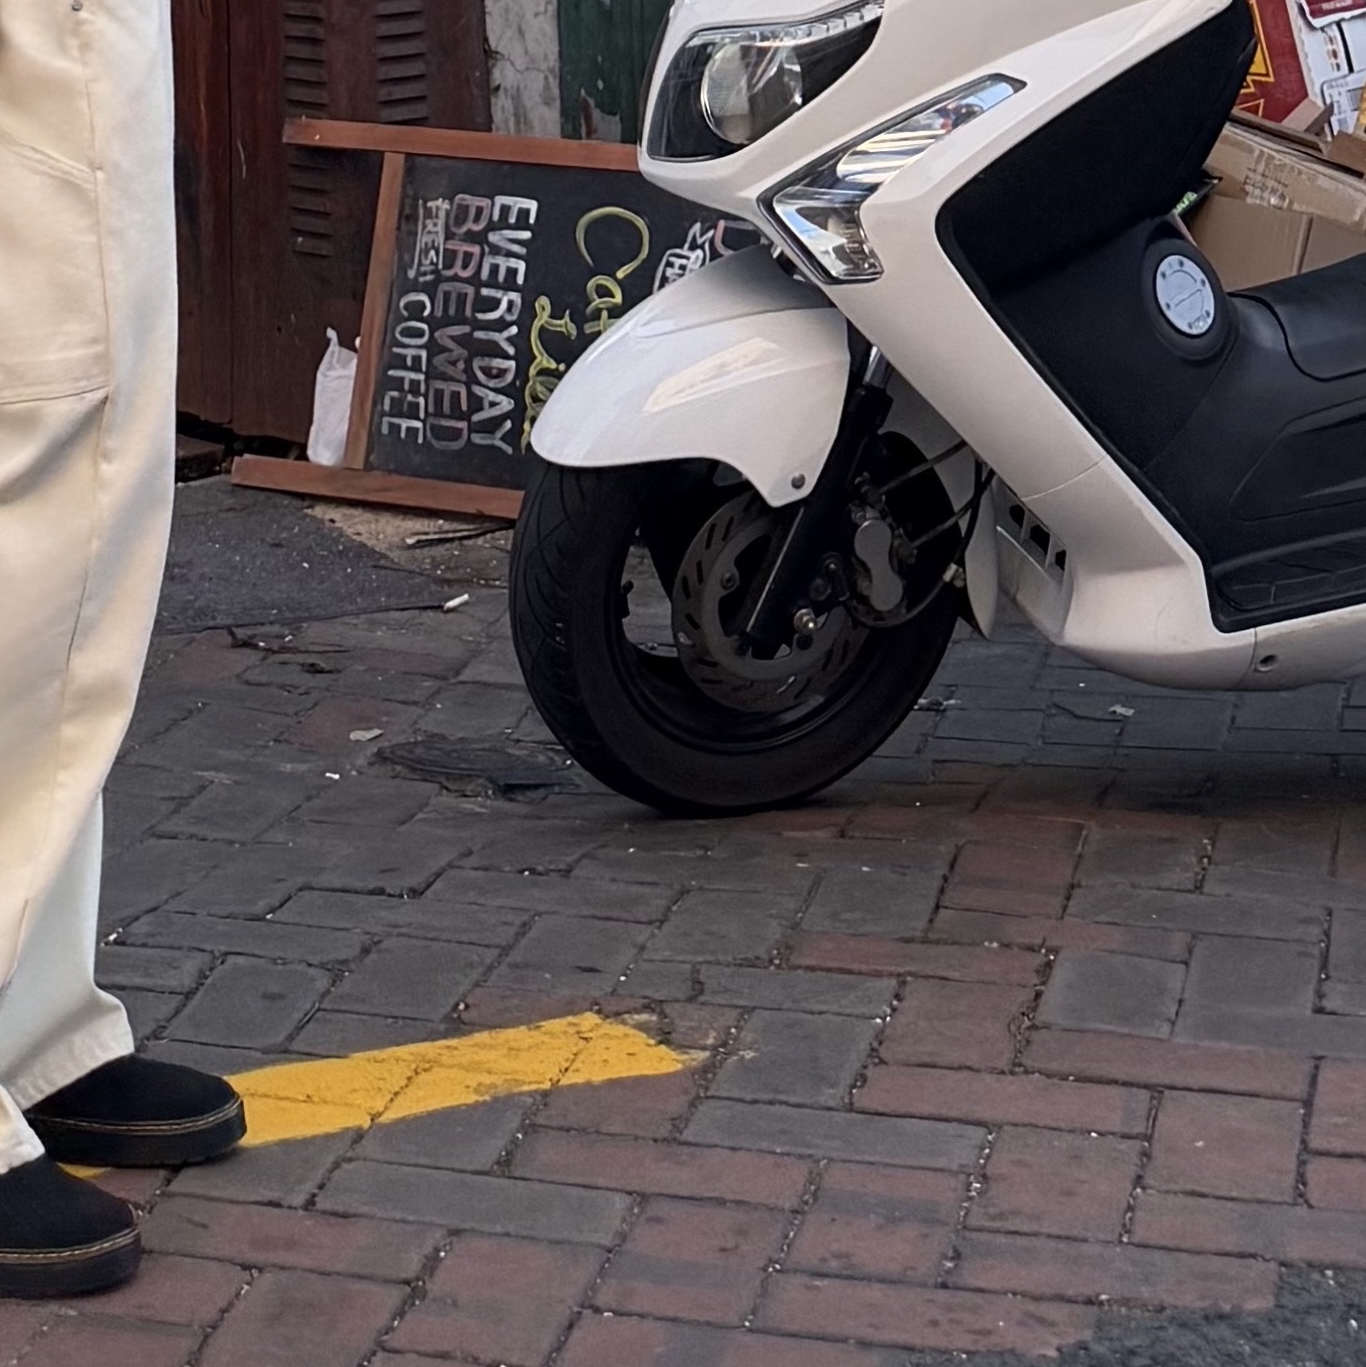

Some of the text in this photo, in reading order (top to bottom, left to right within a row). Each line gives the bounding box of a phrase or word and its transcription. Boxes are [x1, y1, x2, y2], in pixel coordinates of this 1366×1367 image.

[381, 292, 432, 444] COFFEE
[426, 193, 491, 451] BREWED
[471, 194, 538, 455] EVERYDAY
